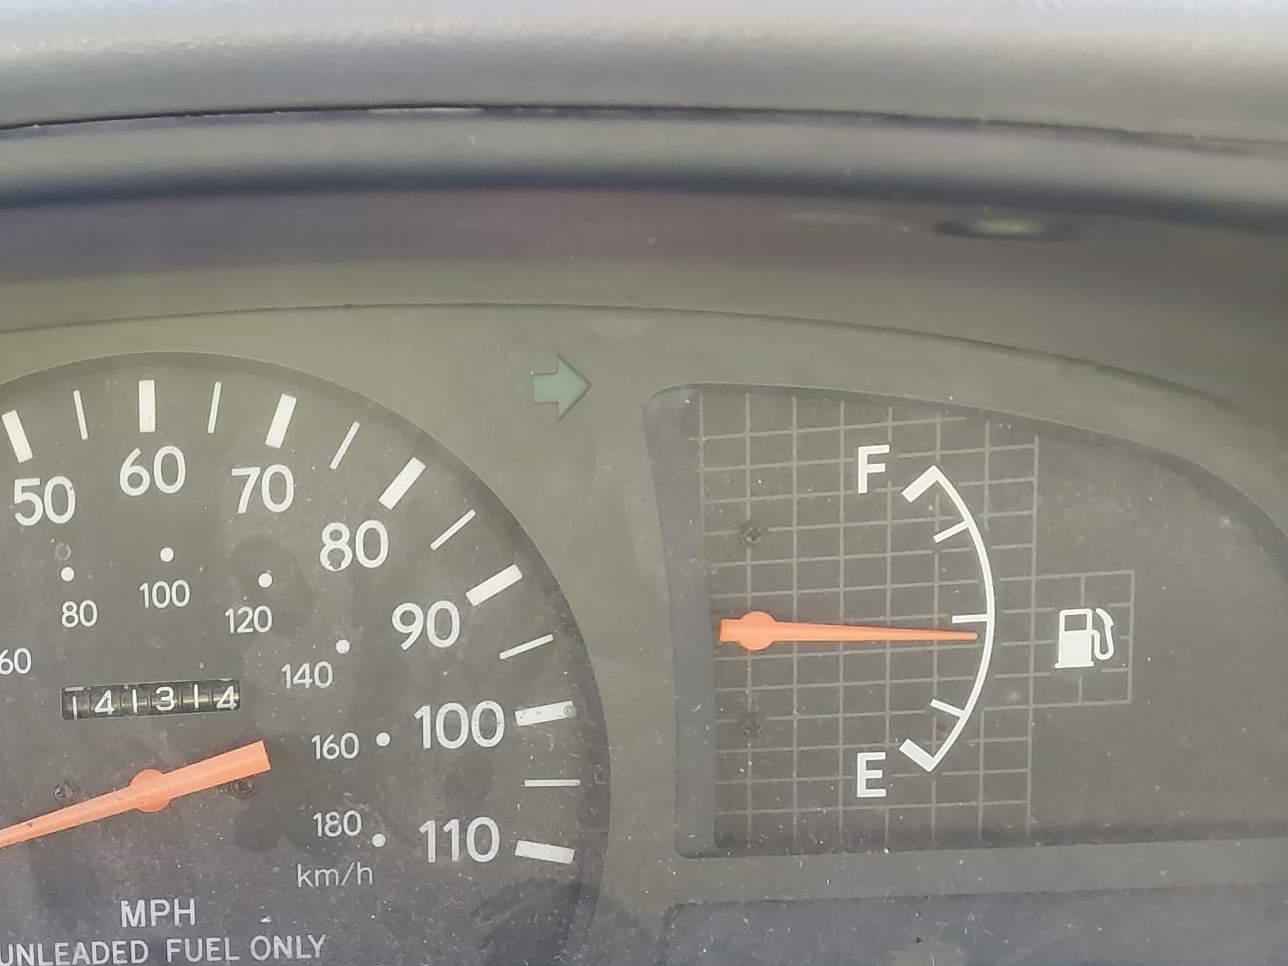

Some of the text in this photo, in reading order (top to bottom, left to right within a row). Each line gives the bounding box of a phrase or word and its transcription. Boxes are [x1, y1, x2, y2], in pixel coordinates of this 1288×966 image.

[119, 446, 185, 496] 60
[857, 445, 890, 494] F
[14, 476, 75, 526] 50
[232, 464, 294, 513] 70
[320, 520, 389, 571] 80
[139, 580, 190, 608] 100
[61, 600, 97, 627] 80
[225, 605, 272, 634] 120
[392, 601, 460, 650] 90
[281, 662, 333, 689] 140
[414, 700, 505, 749] 100
[312, 733, 359, 760] 160
[856, 752, 886, 797] E
[313, 810, 362, 837] 180
[419, 816, 500, 863] 110
[297, 862, 373, 888] km/h
[121, 898, 196, 928] MPH
[166, 937, 240, 962] FUEL
[250, 934, 326, 960] ONLY
